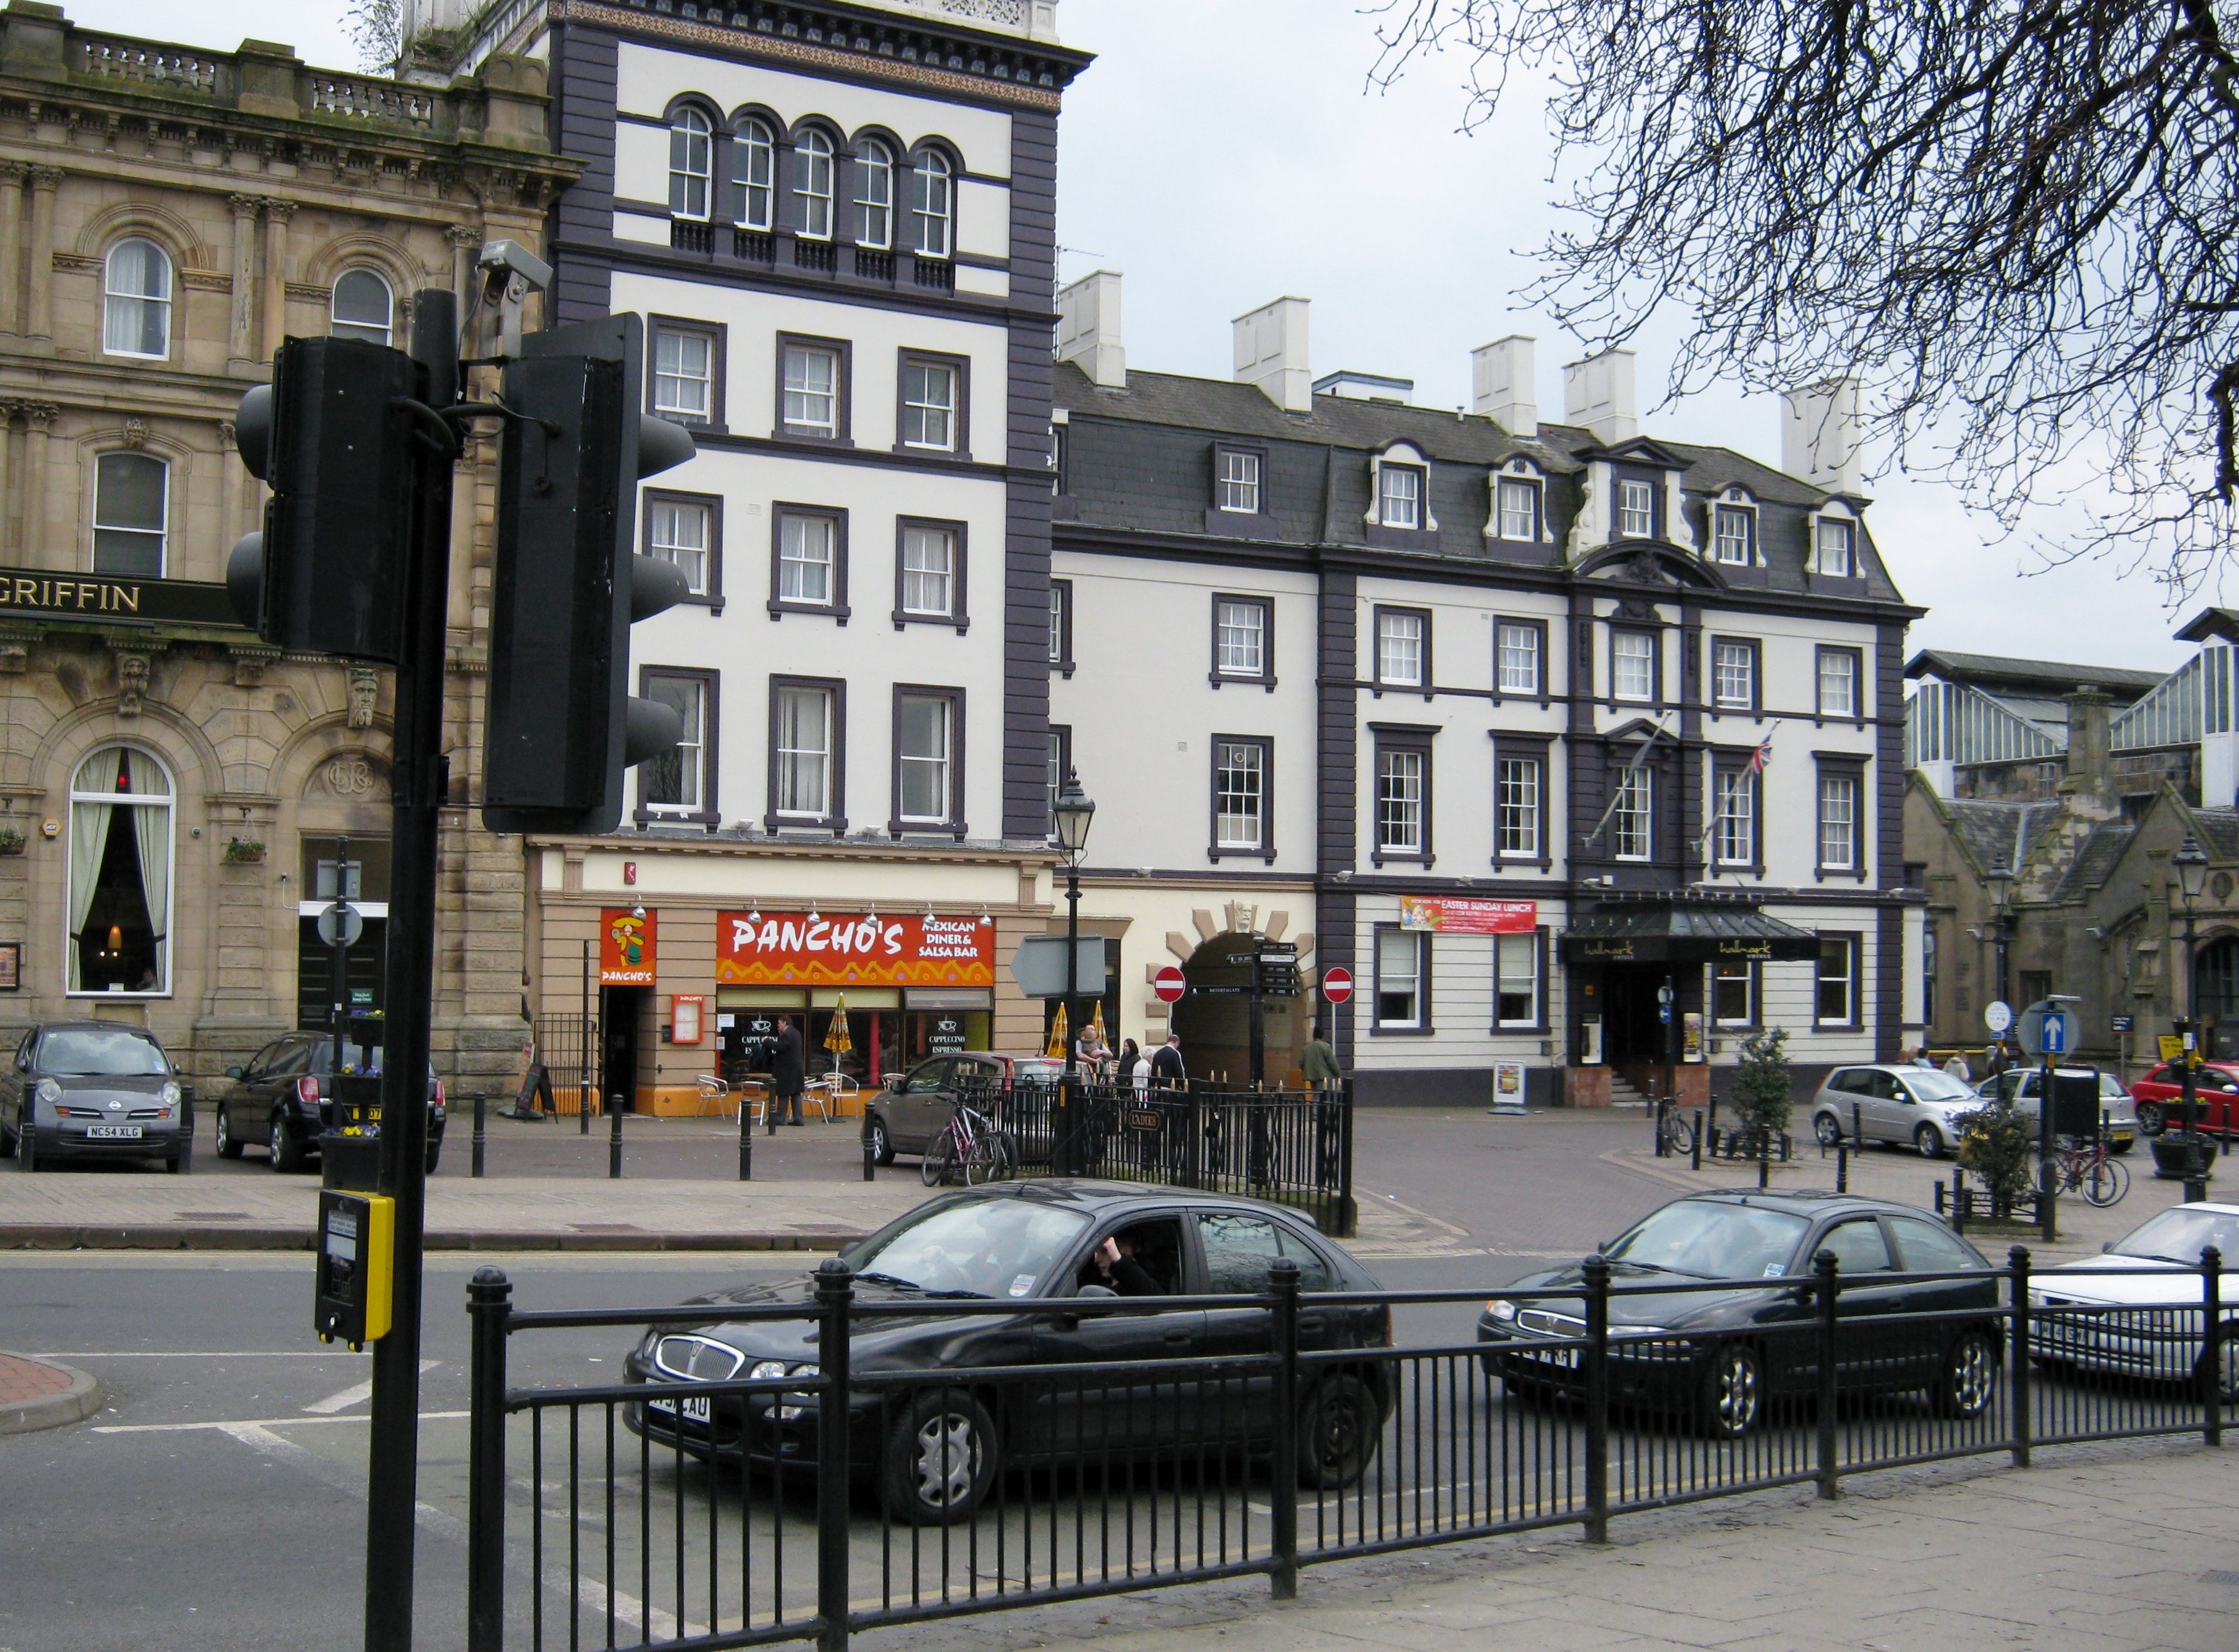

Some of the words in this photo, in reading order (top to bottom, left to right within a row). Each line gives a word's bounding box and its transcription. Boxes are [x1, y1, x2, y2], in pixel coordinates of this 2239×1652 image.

[1441, 900, 1469, 910] EASTER
[1471, 902, 1502, 912] SUNDAY
[1503, 903, 1531, 912] LUNCH
[922, 921, 976, 932] MEXICAN
[732, 920, 904, 954] PANCHO'S
[919, 946, 952, 957] SALSA
[954, 947, 977, 957] BAR
[1720, 940, 1771, 953] hallmark
[602, 971, 652, 982] PANCHO'S
[1131, 1114, 1157, 1126] LADIES
[91, 1128, 116, 1136] NC54
[120, 1128, 138, 1136] XLG
